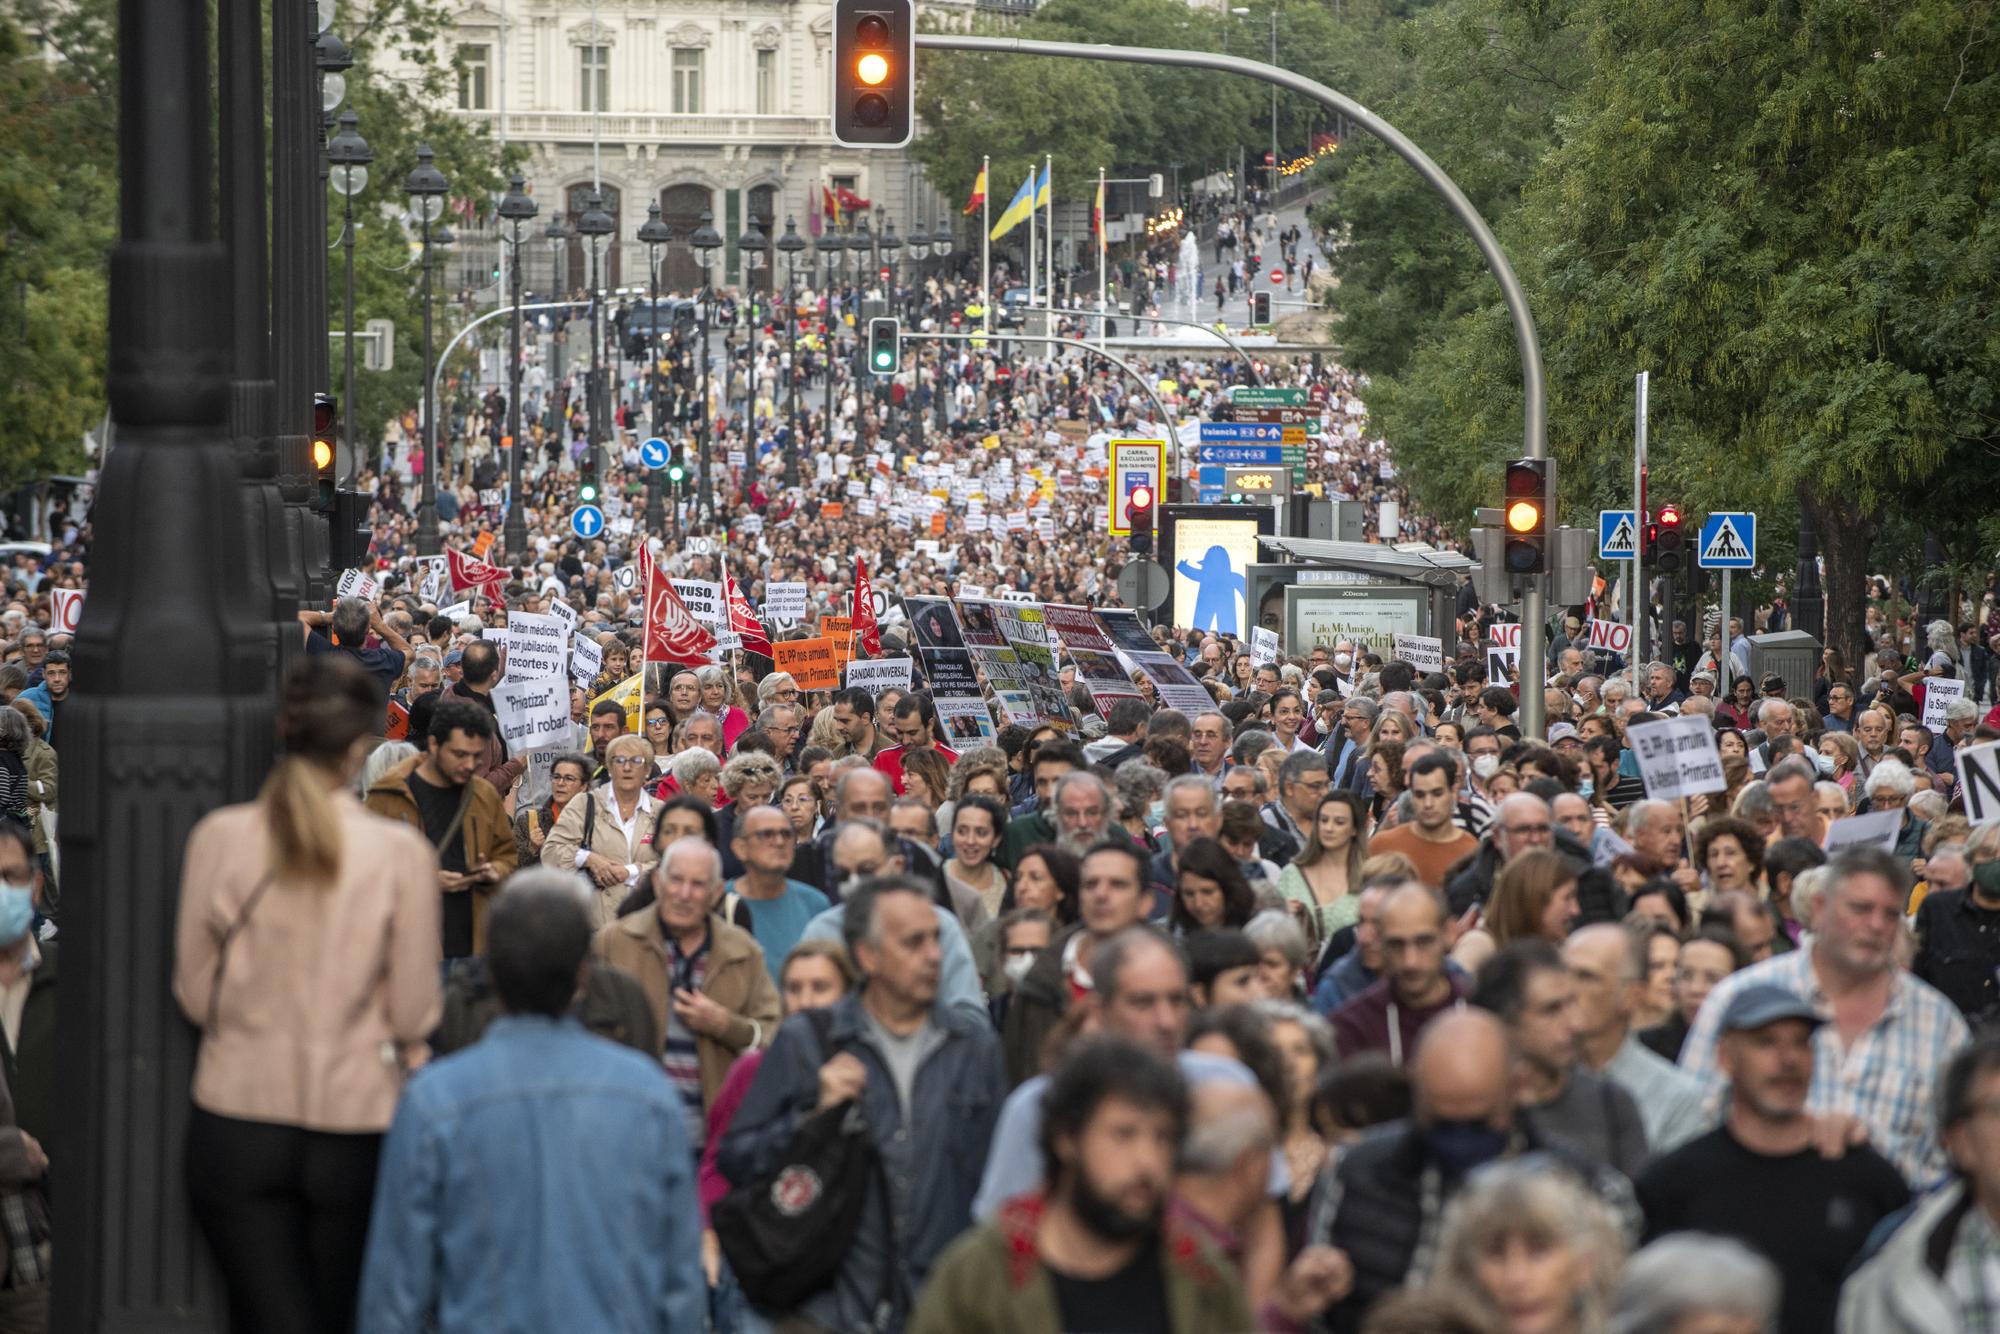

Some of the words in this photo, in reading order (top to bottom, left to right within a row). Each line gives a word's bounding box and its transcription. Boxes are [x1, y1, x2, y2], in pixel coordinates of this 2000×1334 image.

[1202, 428, 1237, 436] Valencia
[686, 538, 709, 553] NO
[53, 591, 83, 631] NO
[683, 601, 714, 613] USO.
[510, 621, 528, 634] Faltan
[529, 624, 560, 639] médicos,
[1345, 623, 1374, 636] Amigo
[1333, 634, 1394, 648] Cocodril
[1590, 624, 1630, 651] NO
[510, 640, 520, 652] por
[521, 639, 559, 656] jubilación,
[788, 648, 796, 662] PP
[797, 650, 807, 661] nos
[808, 646, 829, 660] arruina
[508, 657, 548, 670] recortes
[552, 662, 558, 673] y
[1399, 651, 1414, 661] FUERA
[1415, 655, 1432, 664] AYUSO
[1491, 653, 1516, 683] N
[1929, 682, 1959, 697] Recuperar
[1929, 698, 1935, 709] la
[527, 717, 534, 735] al
[538, 715, 567, 733] robar.
